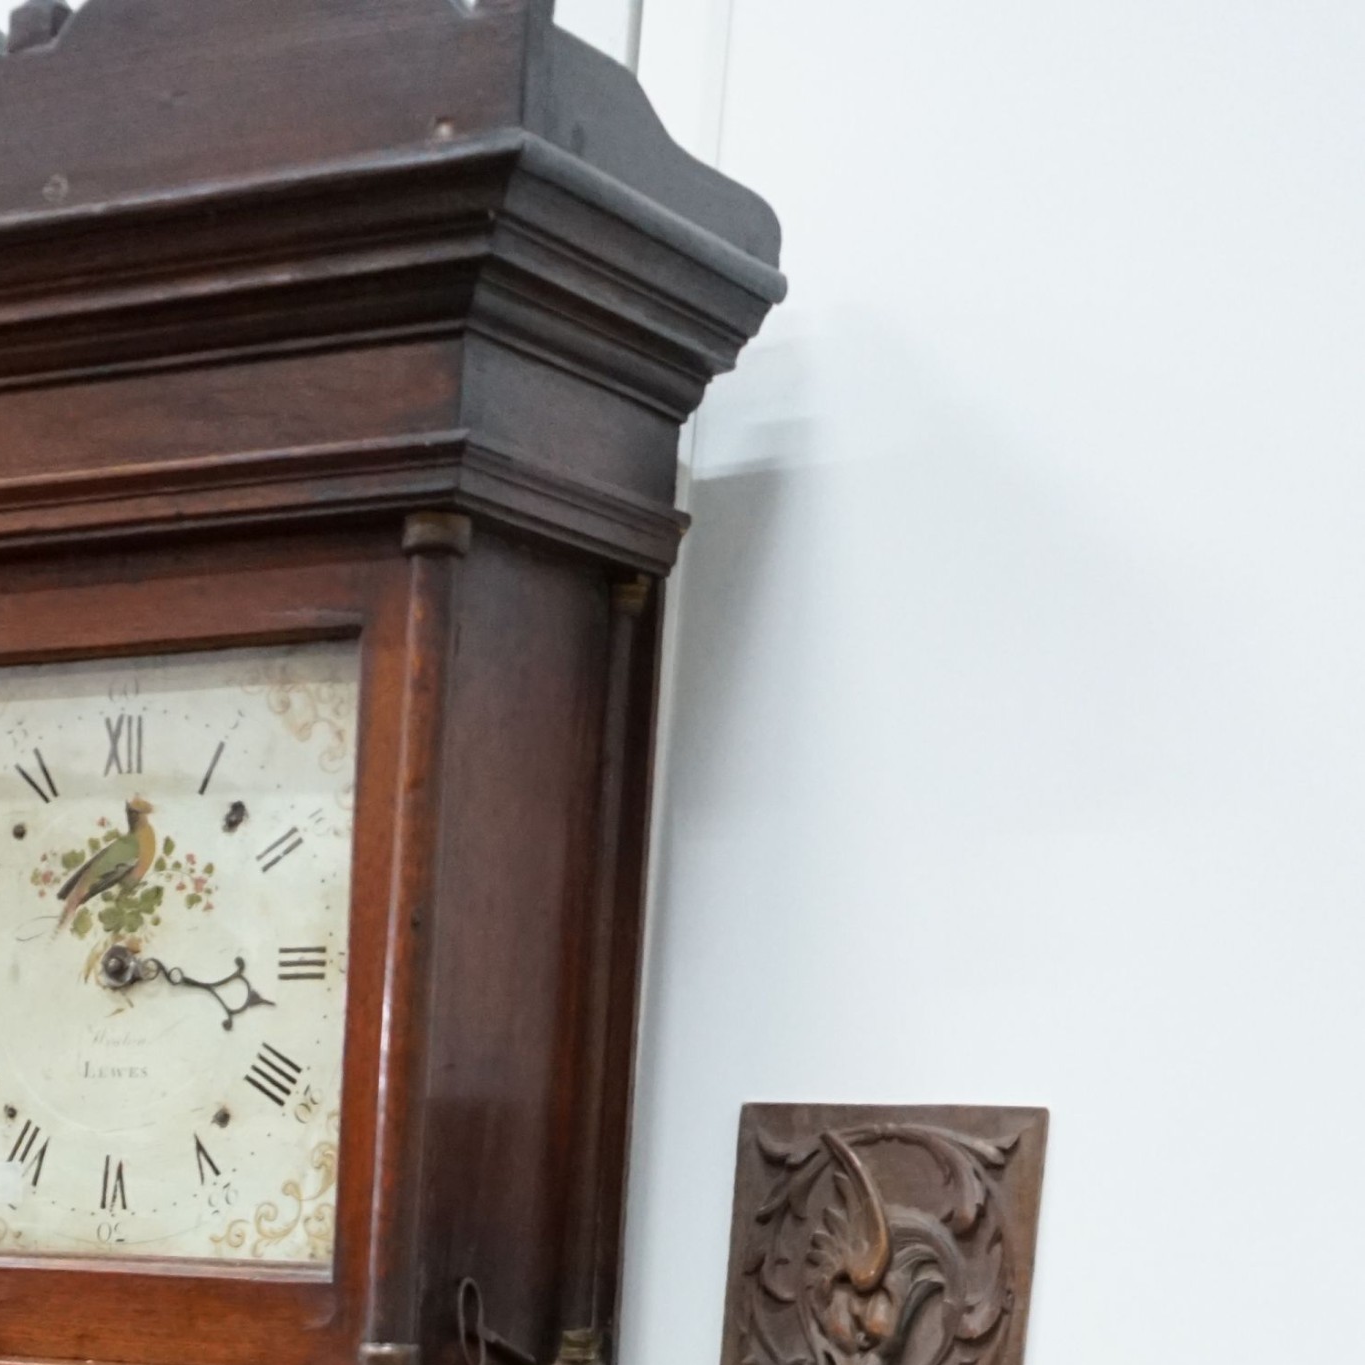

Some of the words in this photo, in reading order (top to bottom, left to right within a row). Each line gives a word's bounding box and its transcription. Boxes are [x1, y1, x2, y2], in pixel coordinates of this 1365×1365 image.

[103, 713, 143, 778] XII
[255, 826, 304, 874] II
[277, 946, 327, 981] III
[83, 1059, 149, 1080] LEWES
[243, 1041, 303, 1108] IIII
[193, 1132, 222, 1187] V
